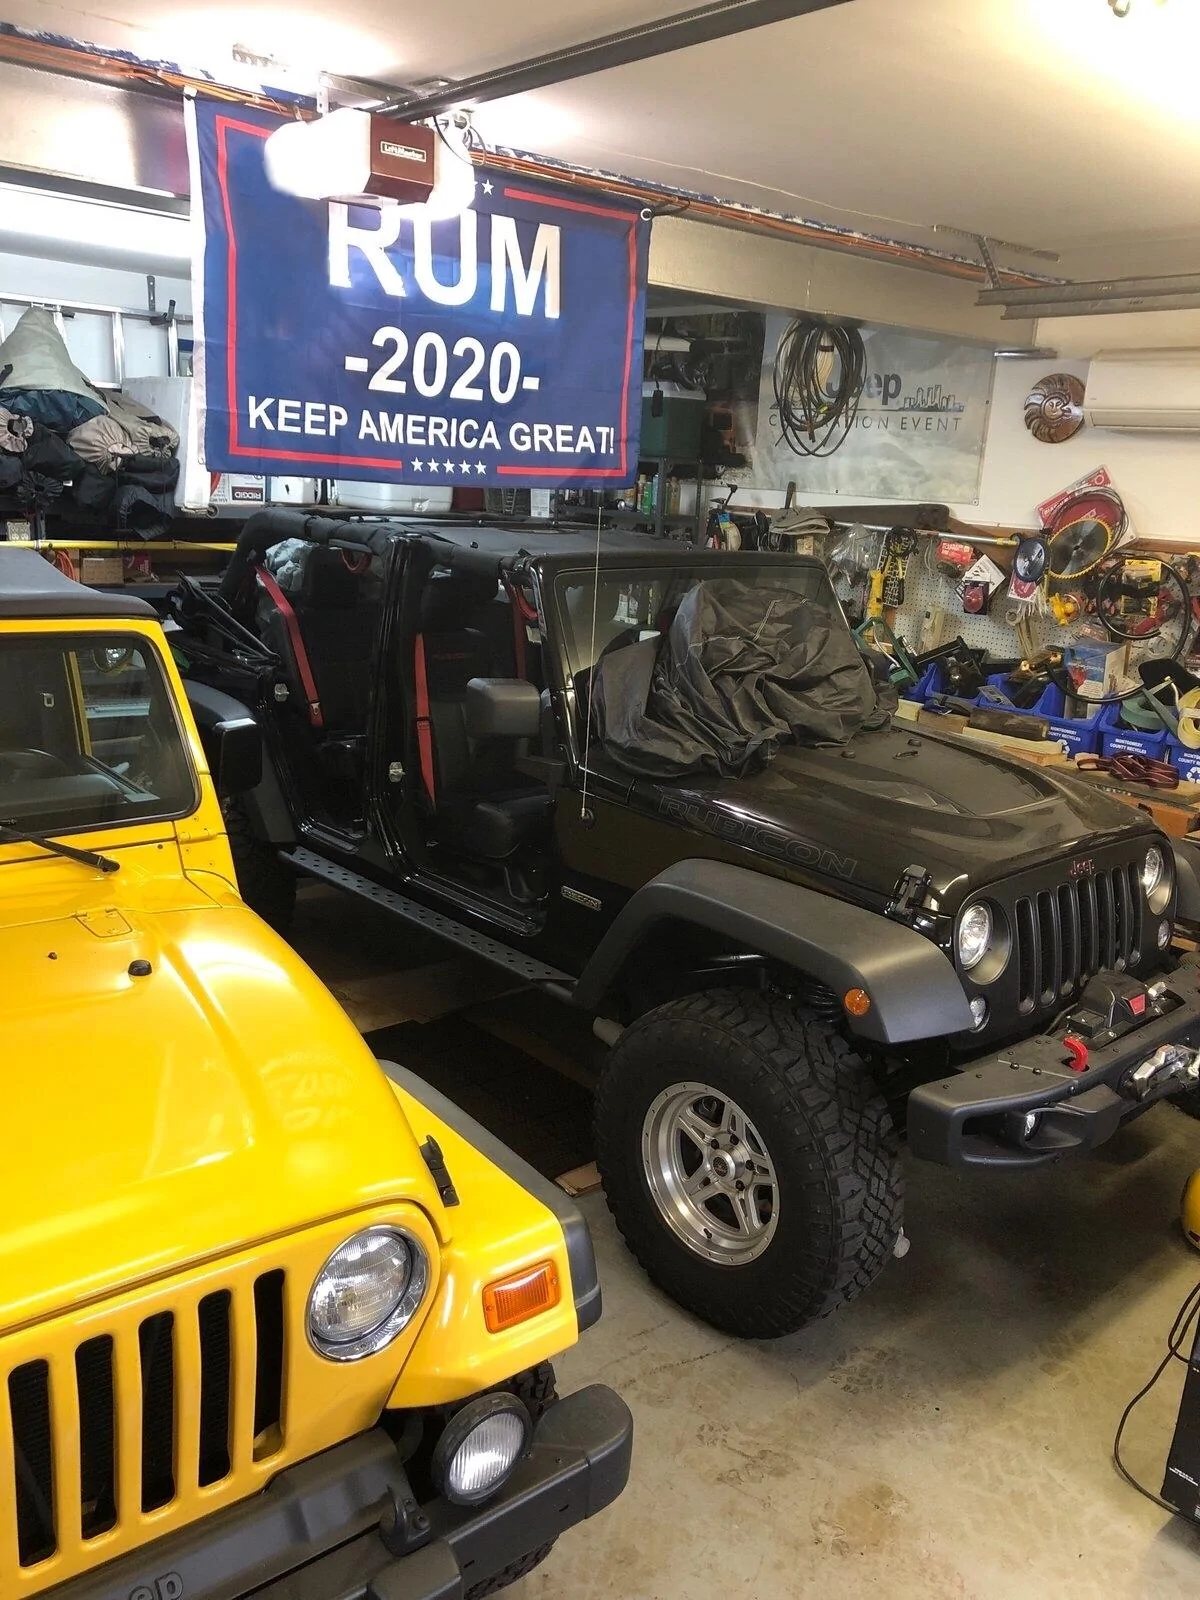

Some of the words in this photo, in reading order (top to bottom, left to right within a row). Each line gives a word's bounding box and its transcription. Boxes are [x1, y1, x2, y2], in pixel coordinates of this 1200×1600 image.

[344, 326, 540, 403] -2020-
[248, 395, 348, 436] KEEP
[358, 409, 501, 450] AMERICA
[509, 422, 615, 454] GREAT!
[901, 416, 962, 431] EVENT
[234, 491, 261, 500] RIDGID
[1110, 743, 1126, 751] COUNTY
[1115, 738, 1143, 748] MONTGOMERY
[658, 796, 858, 878] RUBICON
